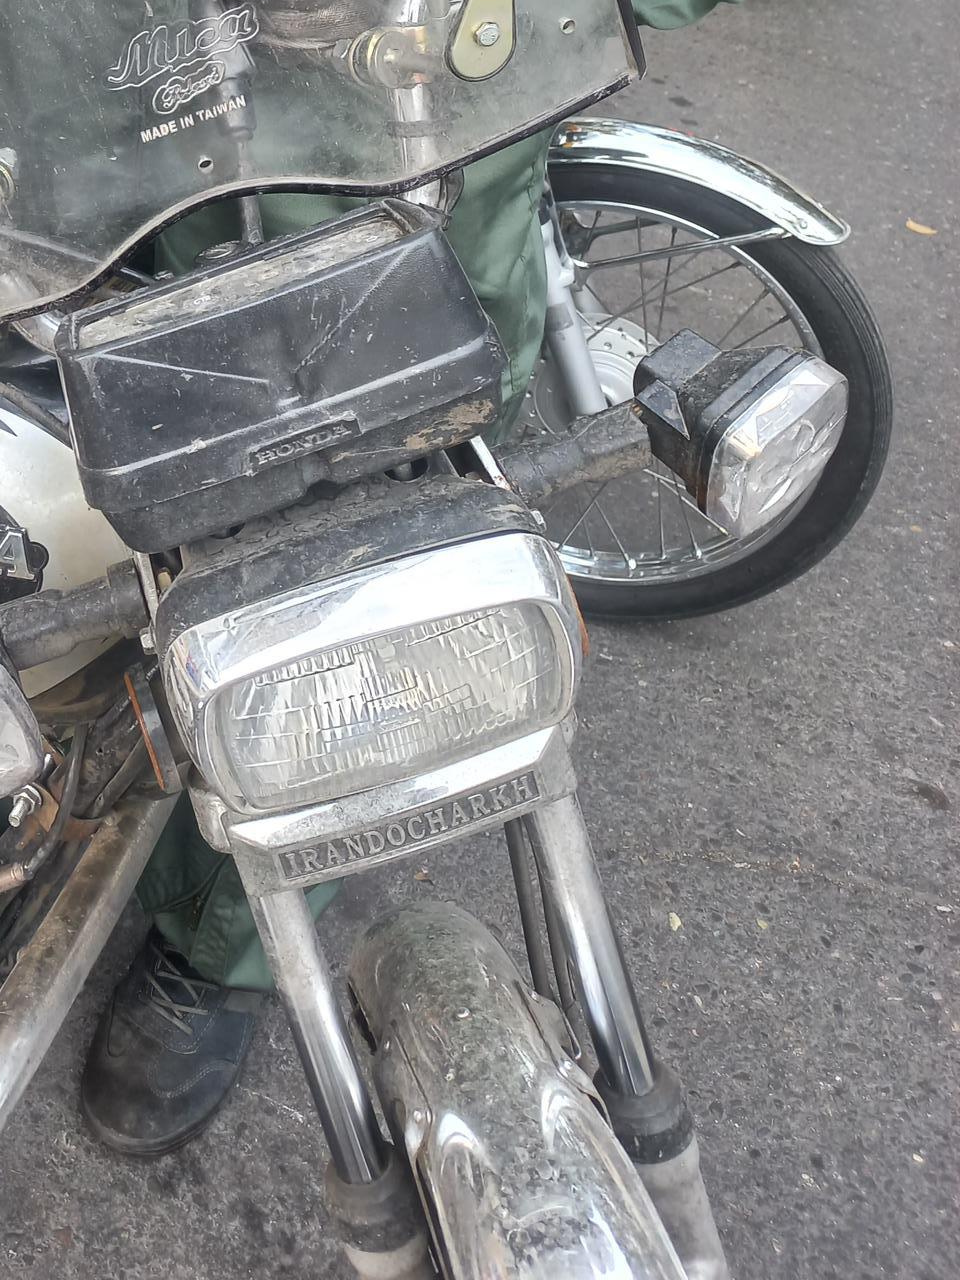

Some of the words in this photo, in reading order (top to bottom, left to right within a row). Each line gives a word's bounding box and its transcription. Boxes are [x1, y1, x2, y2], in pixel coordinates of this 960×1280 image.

[140, 121, 178, 144] MADE
[180, 113, 195, 129] IN
[196, 95, 246, 121] TAIWAN
[256, 424, 352, 465] HONDA
[286, 775, 534, 874] IRANDOCHARKH
